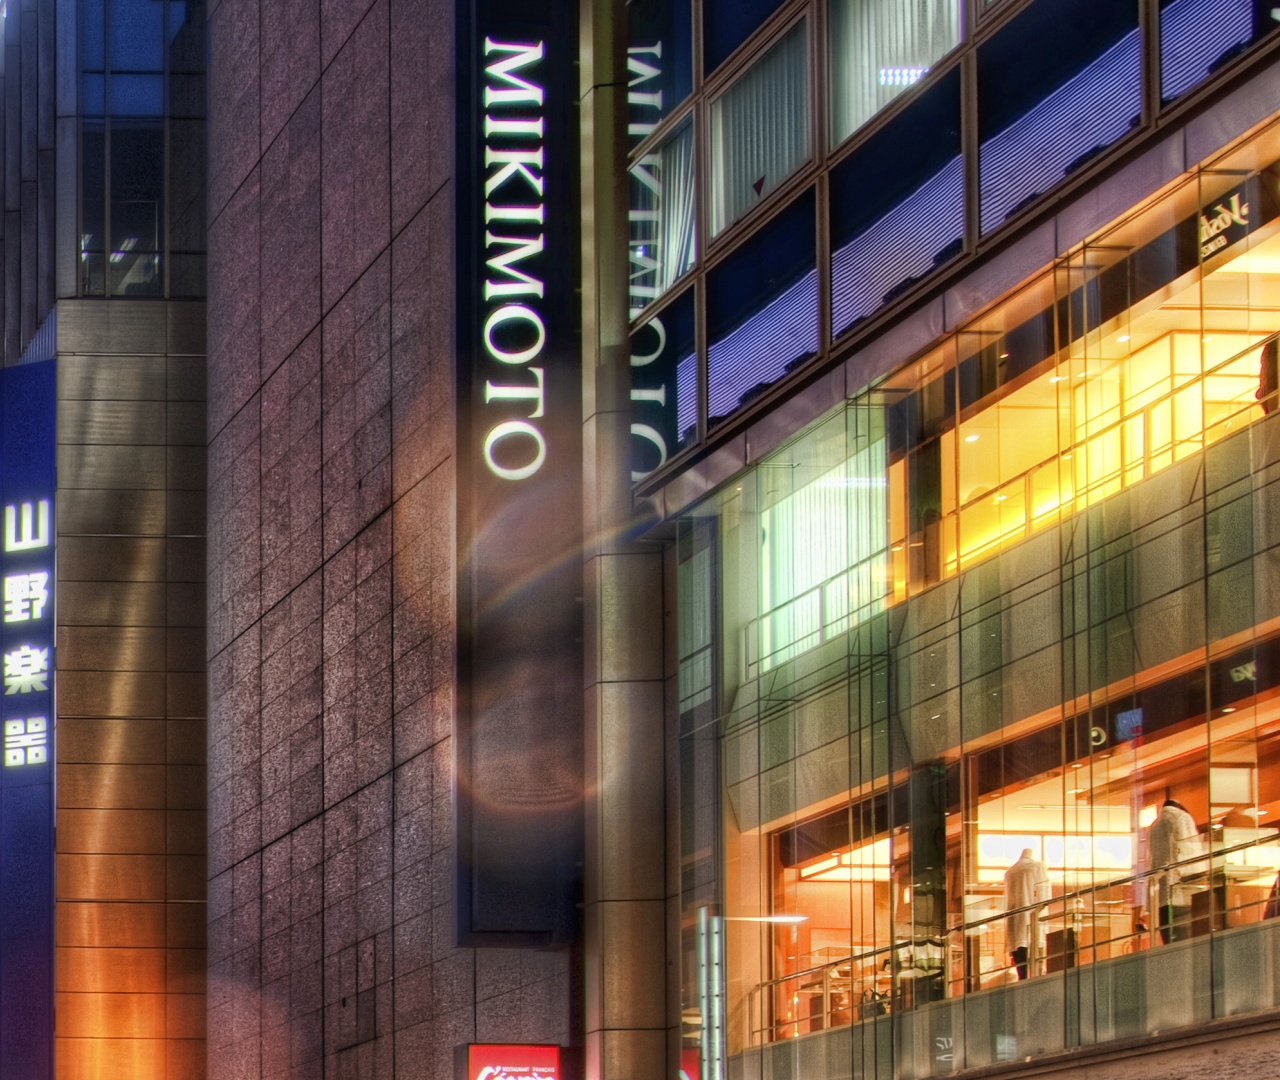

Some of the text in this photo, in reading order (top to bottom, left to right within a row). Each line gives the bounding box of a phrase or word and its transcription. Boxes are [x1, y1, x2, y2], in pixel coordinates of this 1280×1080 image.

[483, 37, 546, 481] MIKIMOTO
[4, 500, 50, 768] 山野楽器
